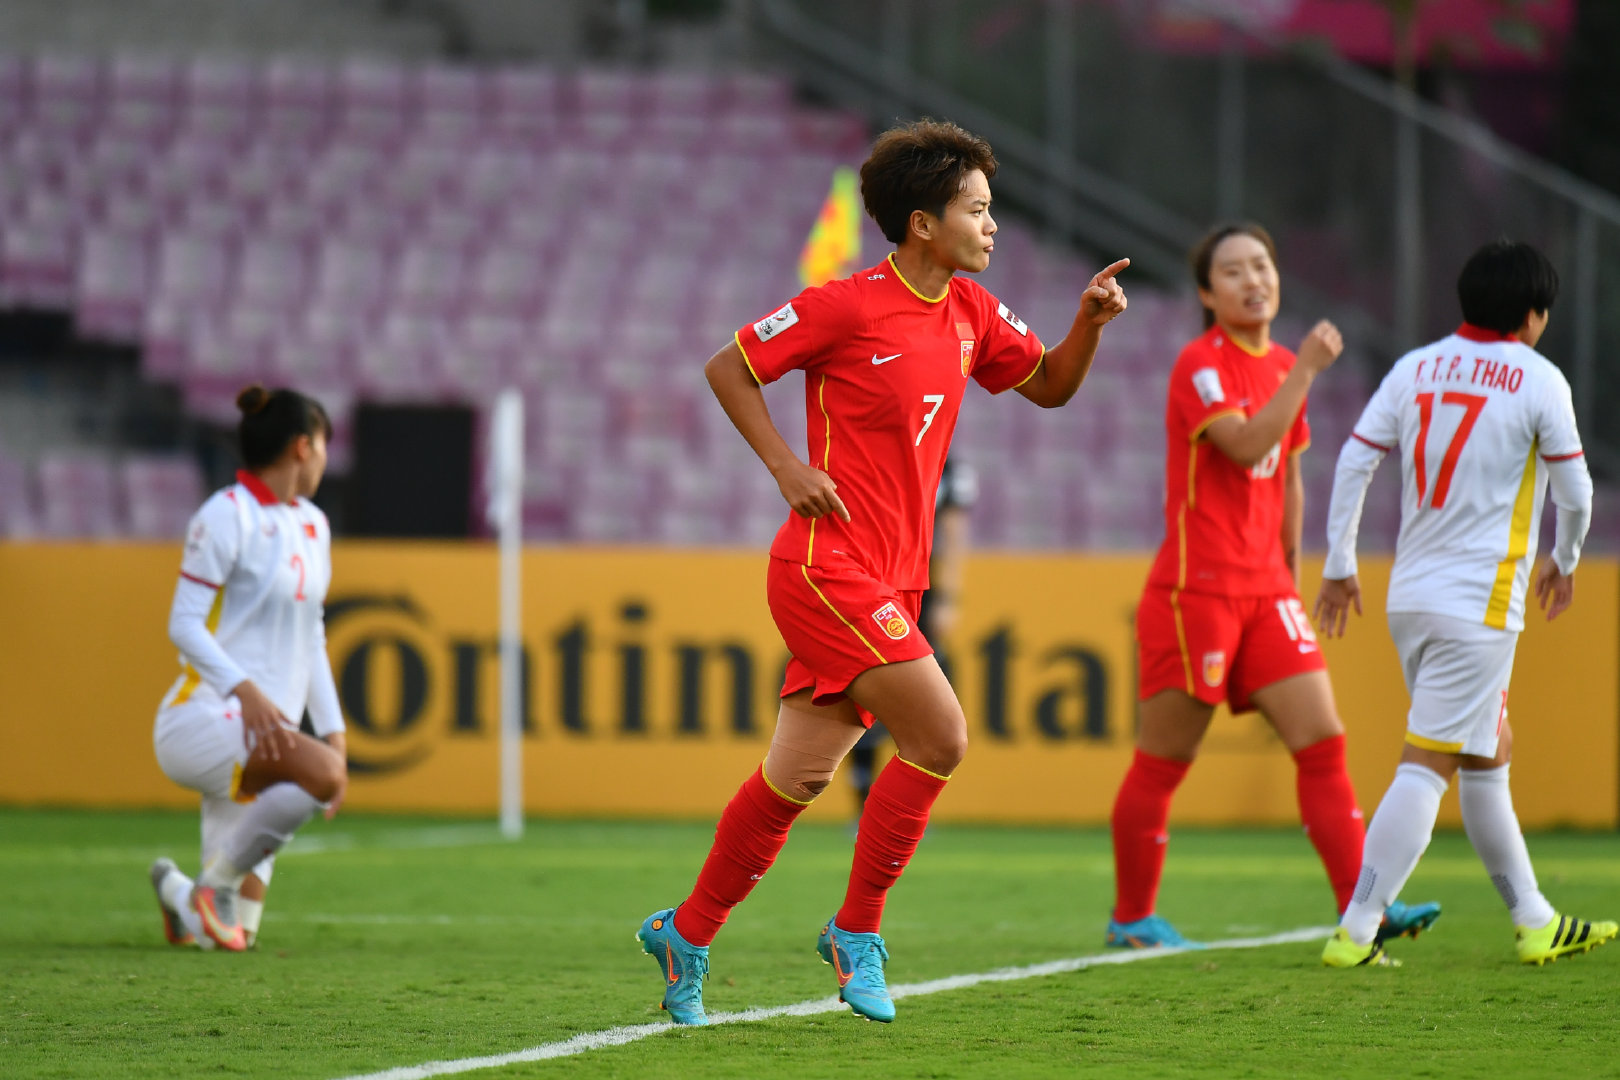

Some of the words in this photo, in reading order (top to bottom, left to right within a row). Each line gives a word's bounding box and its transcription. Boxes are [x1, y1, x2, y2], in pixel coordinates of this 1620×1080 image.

[1471, 358, 1524, 394] THAO
[915, 394, 945, 446] 7
[1414, 391, 1488, 510] 17
[290, 553, 307, 602] 2
